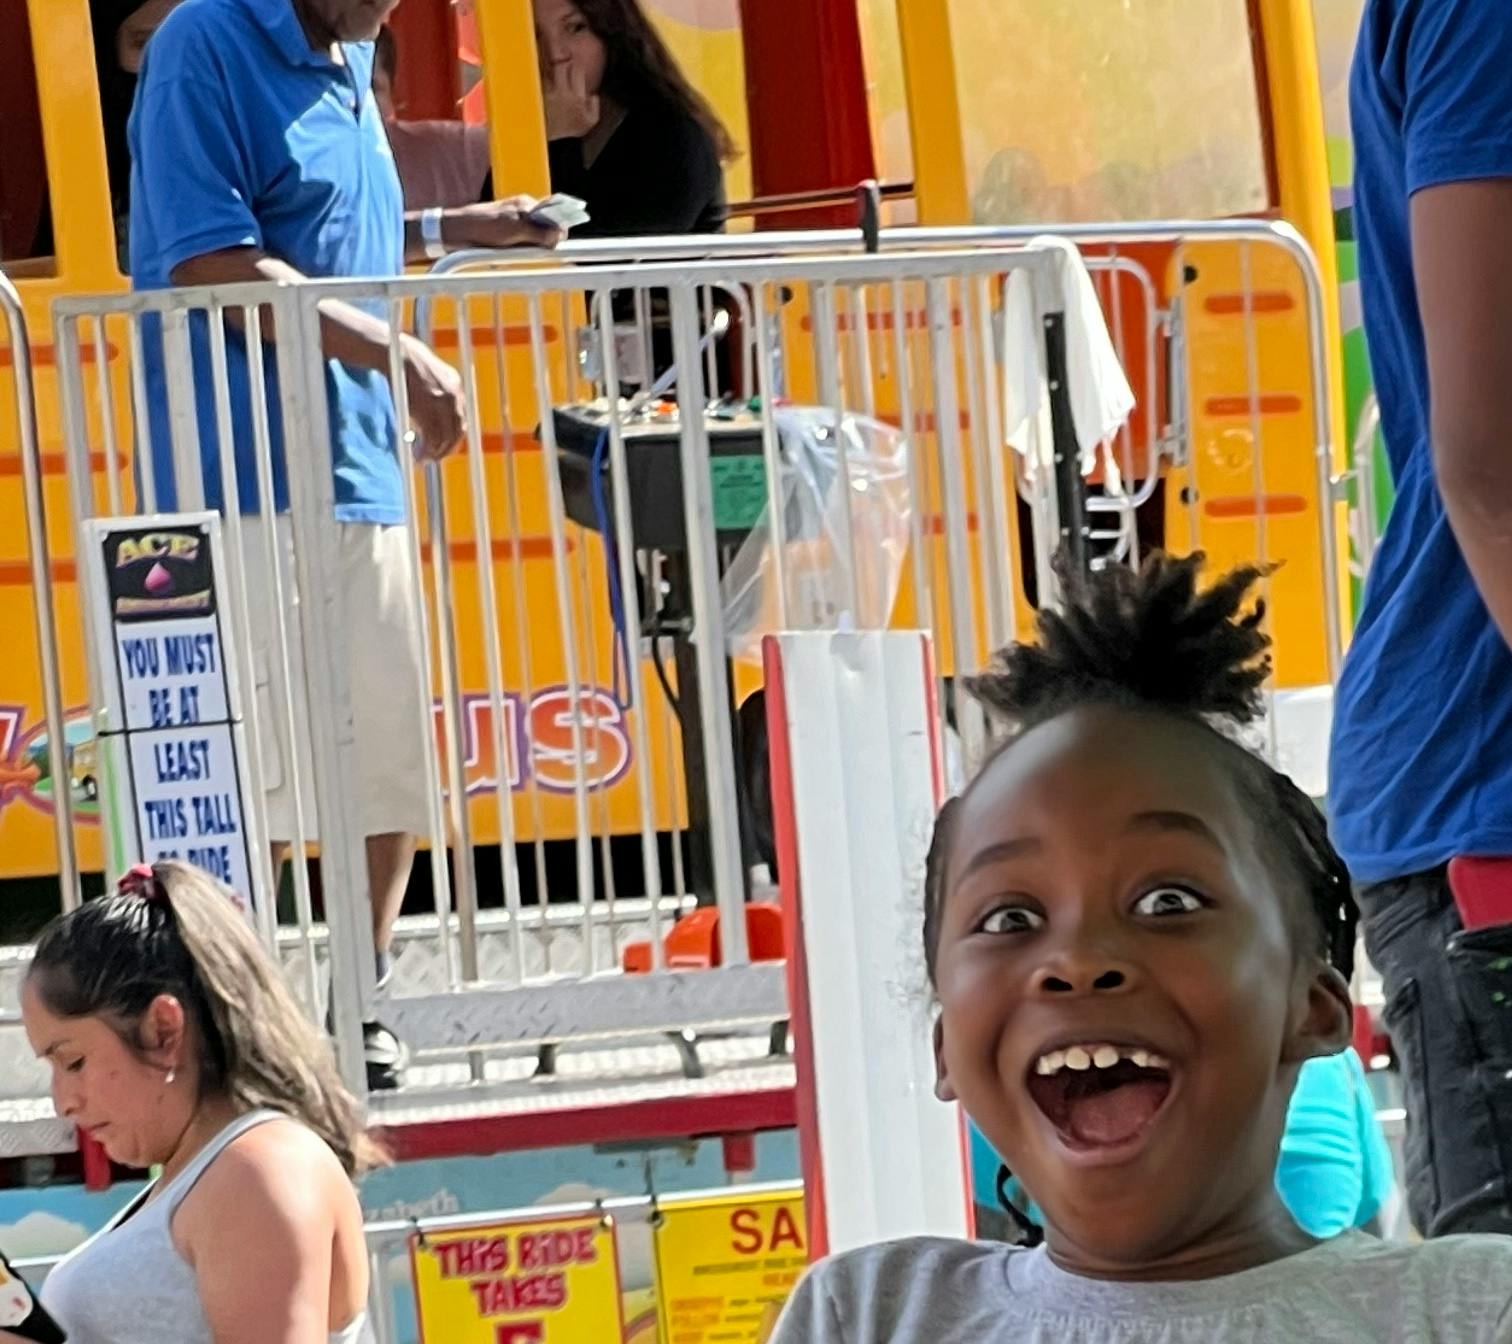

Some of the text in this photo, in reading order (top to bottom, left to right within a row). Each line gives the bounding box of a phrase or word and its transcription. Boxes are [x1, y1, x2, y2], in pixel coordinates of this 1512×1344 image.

[115, 532, 199, 568] ACE
[122, 633, 216, 679] YOU MUST
[149, 686, 200, 728] BE AT
[154, 739, 210, 783] LEAST
[145, 793, 237, 840] THIS TALL
[470, 1272, 567, 1317] TAKES
